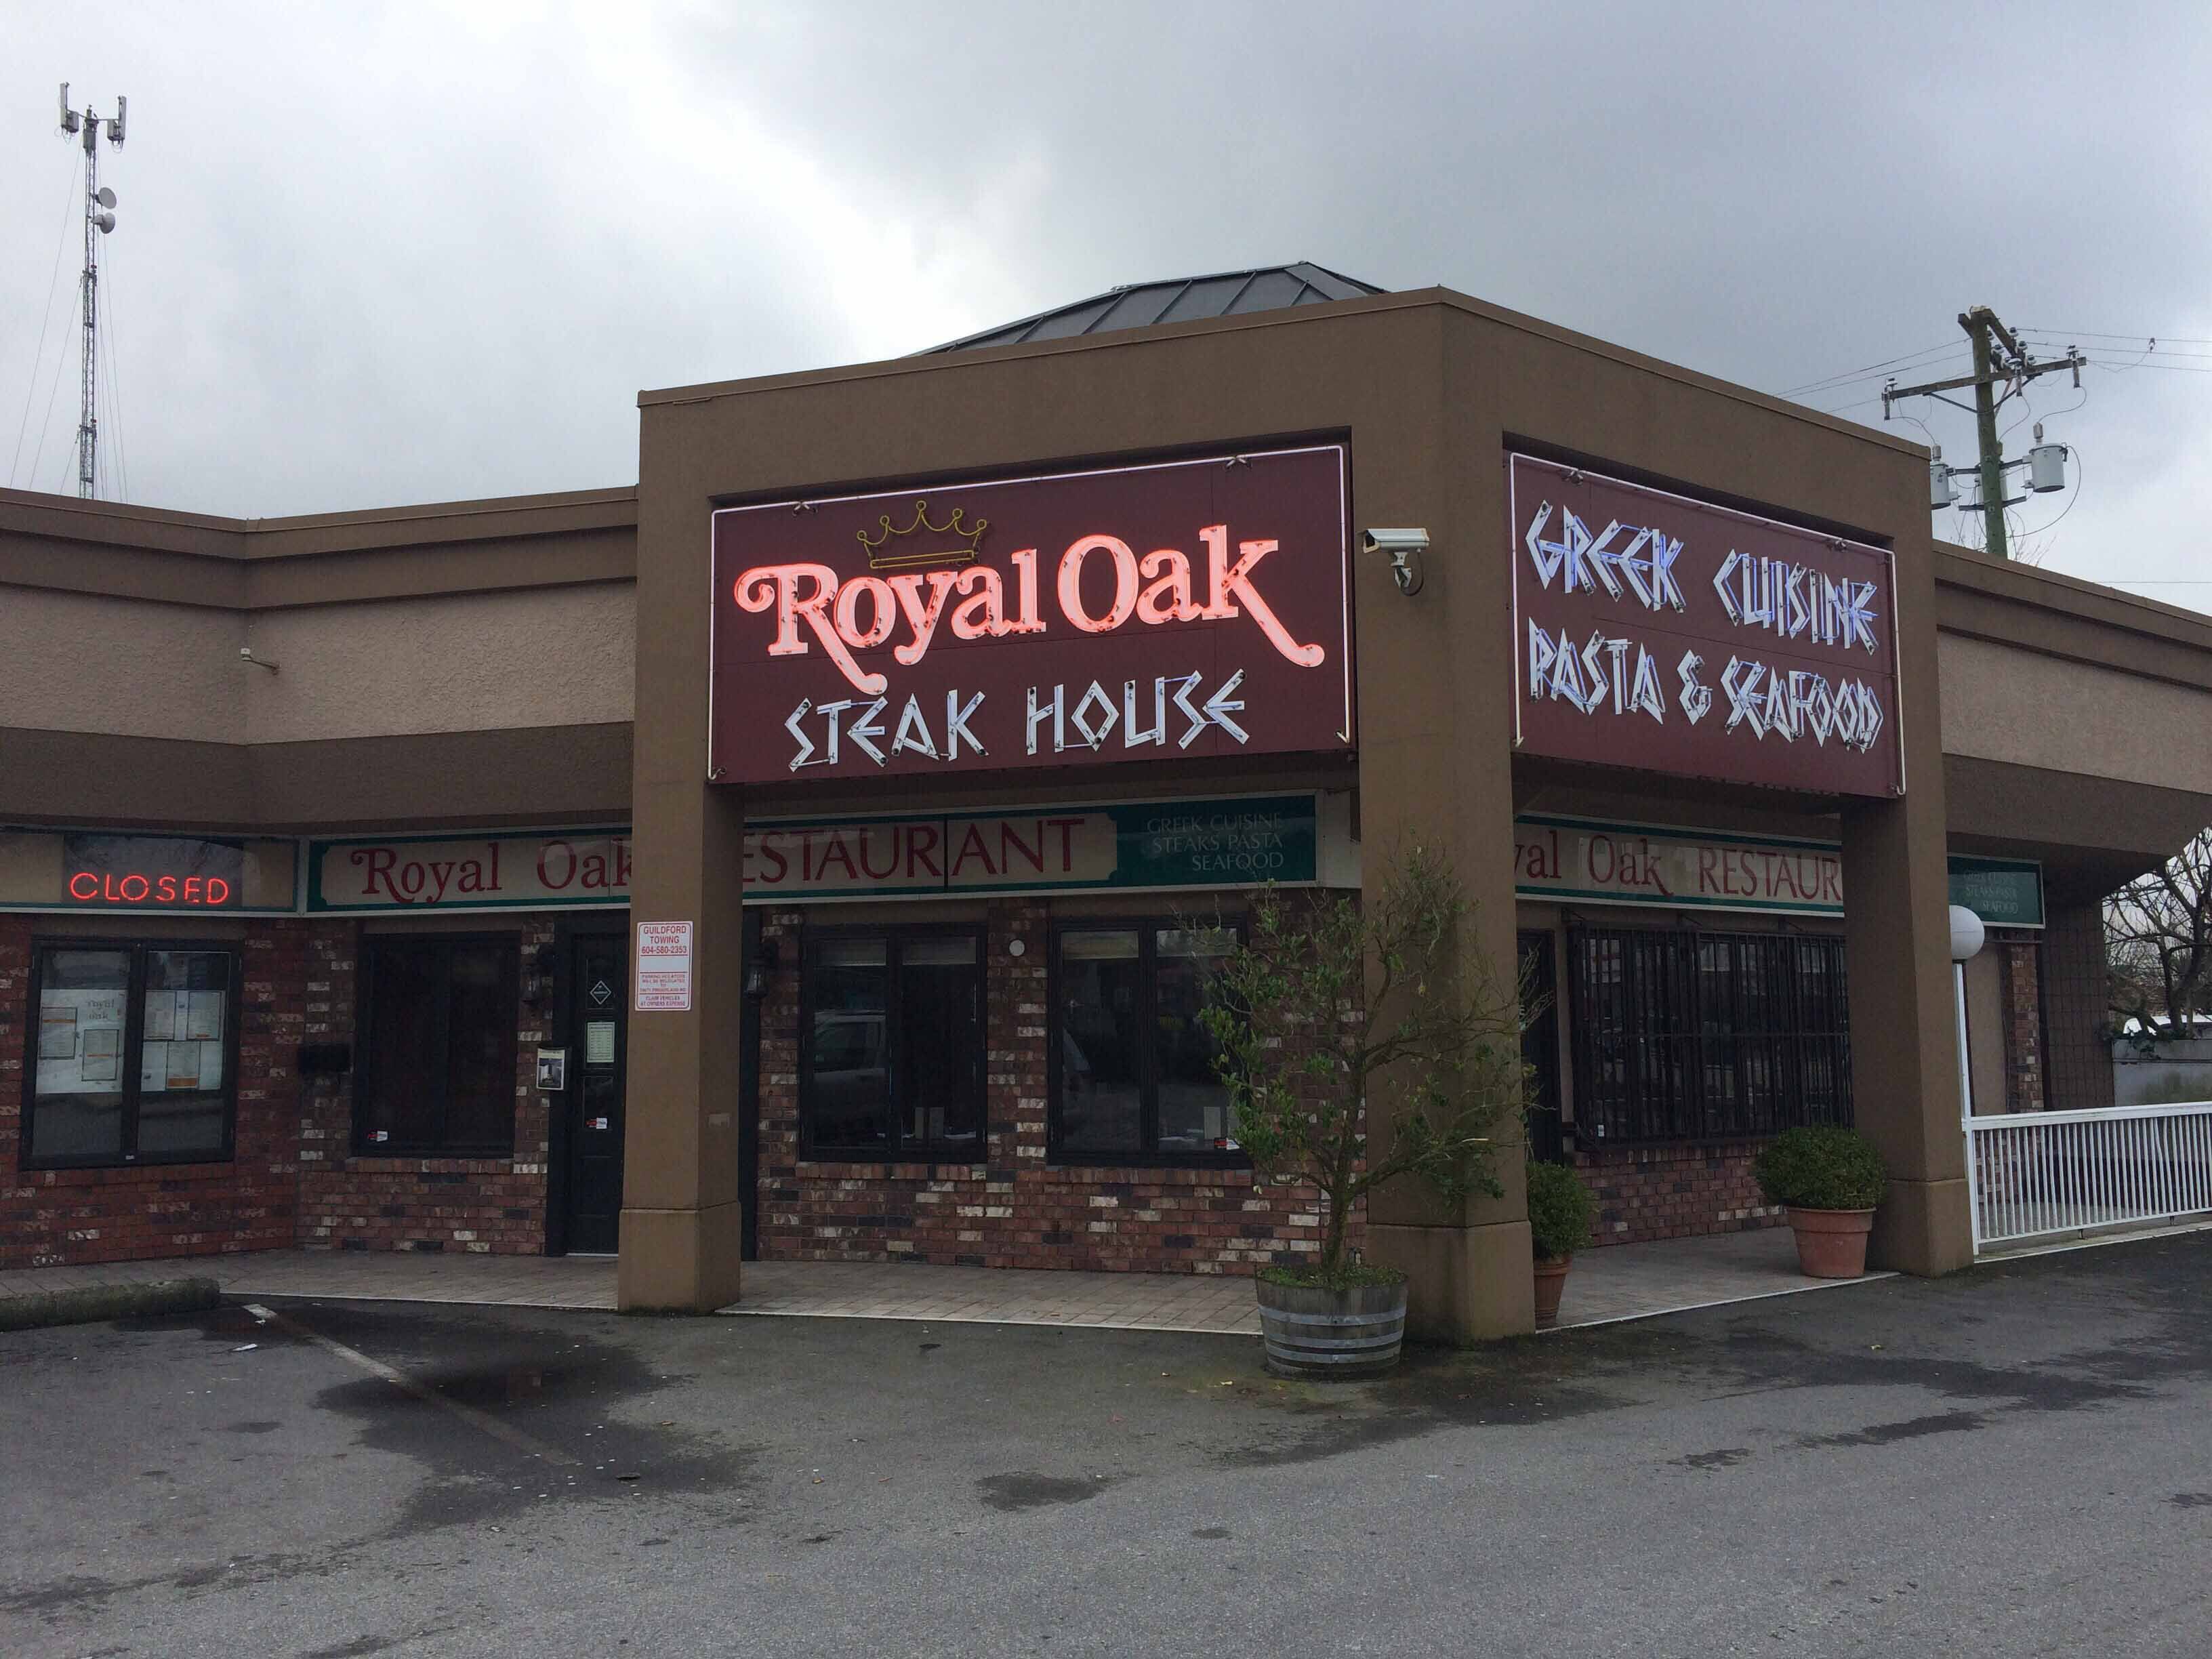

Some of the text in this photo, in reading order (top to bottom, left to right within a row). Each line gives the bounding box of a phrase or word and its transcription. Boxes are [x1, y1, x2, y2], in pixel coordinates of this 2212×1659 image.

[1525, 499, 1879, 655] GREEK CUISINE
[733, 525, 1326, 696] Royal Oak
[1528, 617, 1666, 725] PASTA
[1721, 655, 1884, 754] SEAFOOD
[784, 669, 1250, 772] STEAK HOUSE
[1147, 813, 1280, 834] GREEK CUISINE
[1152, 832, 1284, 853] STEAKS PASTA
[350, 819, 1085, 905] Royal Oak ESTAURANT
[1192, 851, 1284, 872] SEAFOOD
[1589, 834, 1674, 897] Oak
[1697, 846, 1842, 901] RESTAUR
[70, 872, 230, 904] CLOSED
[643, 926, 687, 935] GUILDFORD
[650, 936, 679, 944] TOWING
